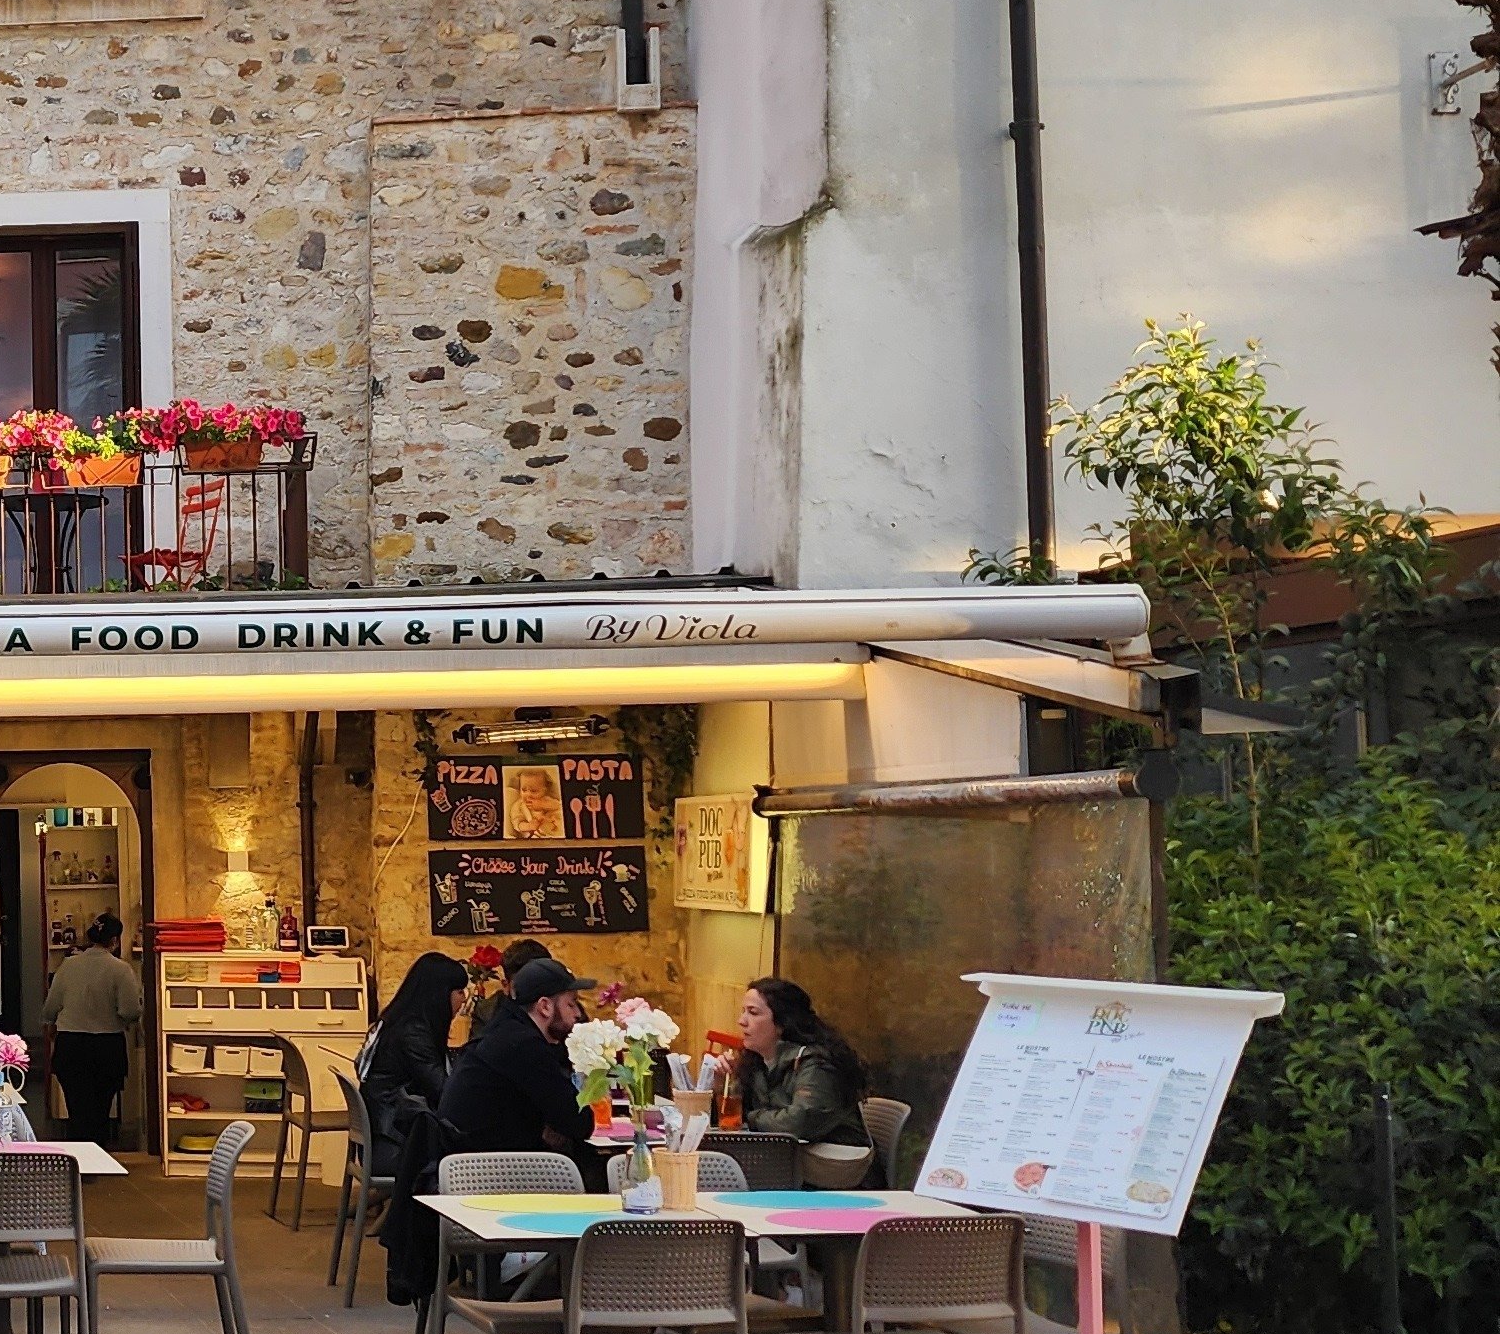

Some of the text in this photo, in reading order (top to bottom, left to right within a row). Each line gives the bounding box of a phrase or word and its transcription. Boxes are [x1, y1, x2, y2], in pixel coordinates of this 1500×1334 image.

[71, 624, 199, 651] FOOD
[238, 620, 384, 648] DRINK
[404, 619, 431, 645] &
[452, 618, 543, 644] FUN
[585, 614, 759, 643] By Viola
[562, 759, 633, 781] PASTA
[699, 807, 723, 837] DOC
[521, 856, 549, 875] Your
[698, 840, 722, 868] PUB
